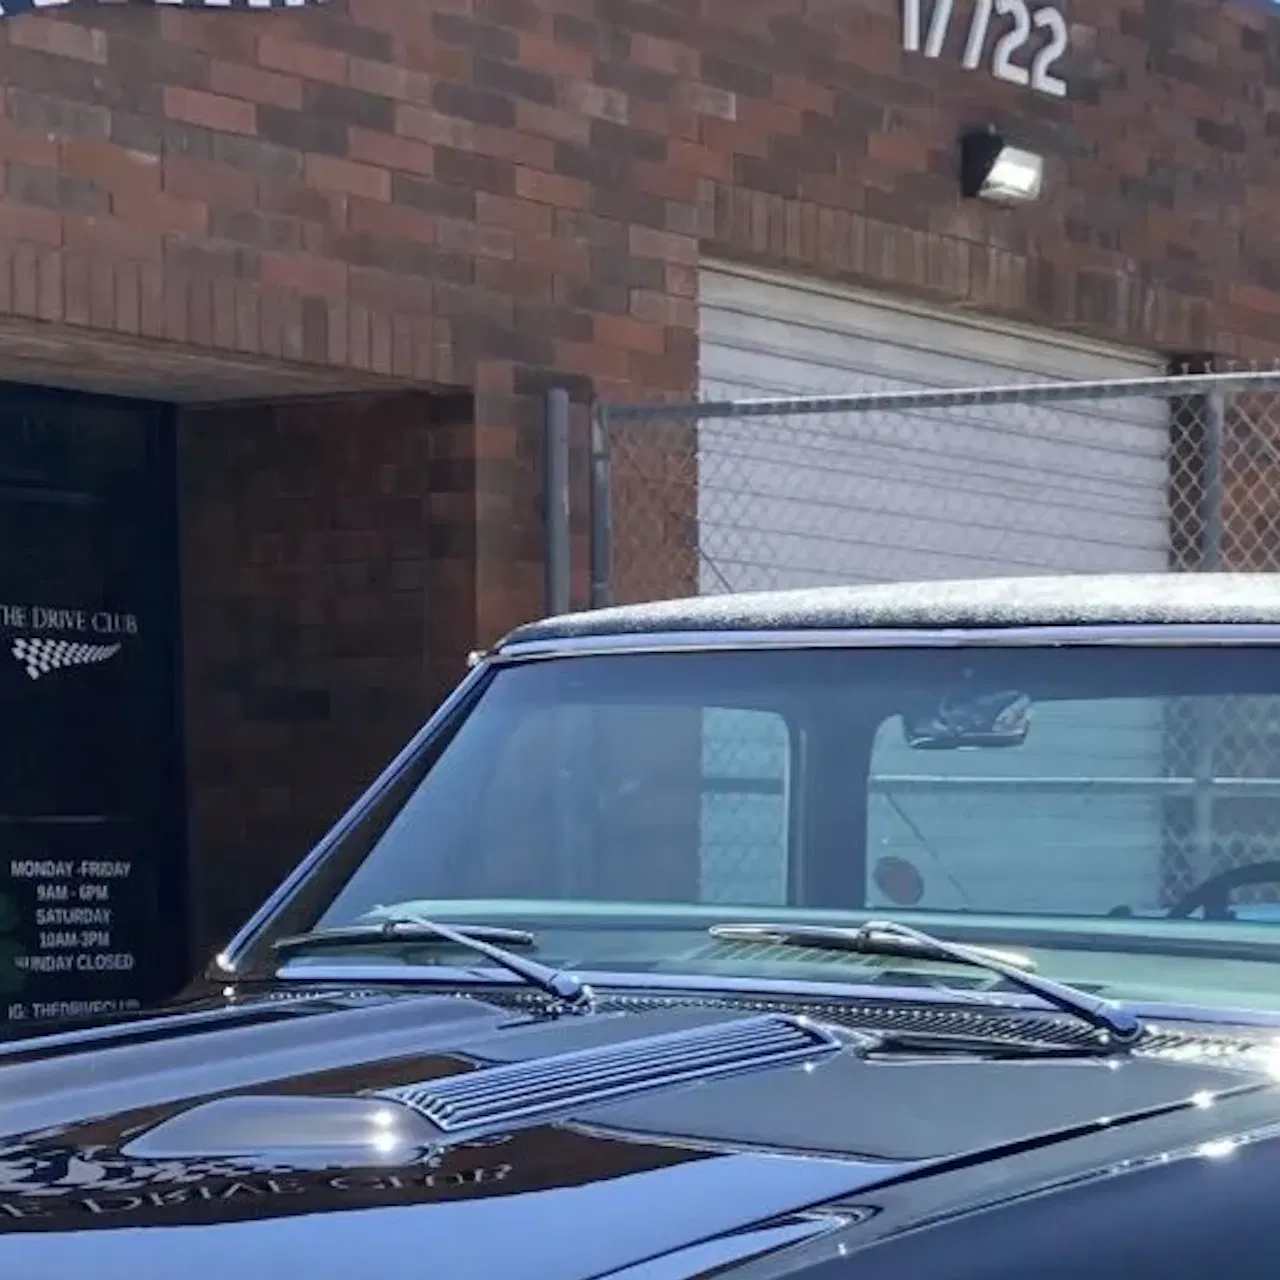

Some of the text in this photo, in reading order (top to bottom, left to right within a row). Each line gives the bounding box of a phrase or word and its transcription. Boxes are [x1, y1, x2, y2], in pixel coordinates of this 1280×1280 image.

[31, 606, 87, 630] DRIVE
[91, 611, 139, 633] CLUB
[10, 859, 74, 878] MONDAY
[35, 908, 112, 925] SATURDAY
[76, 953, 135, 971] CLOSED
